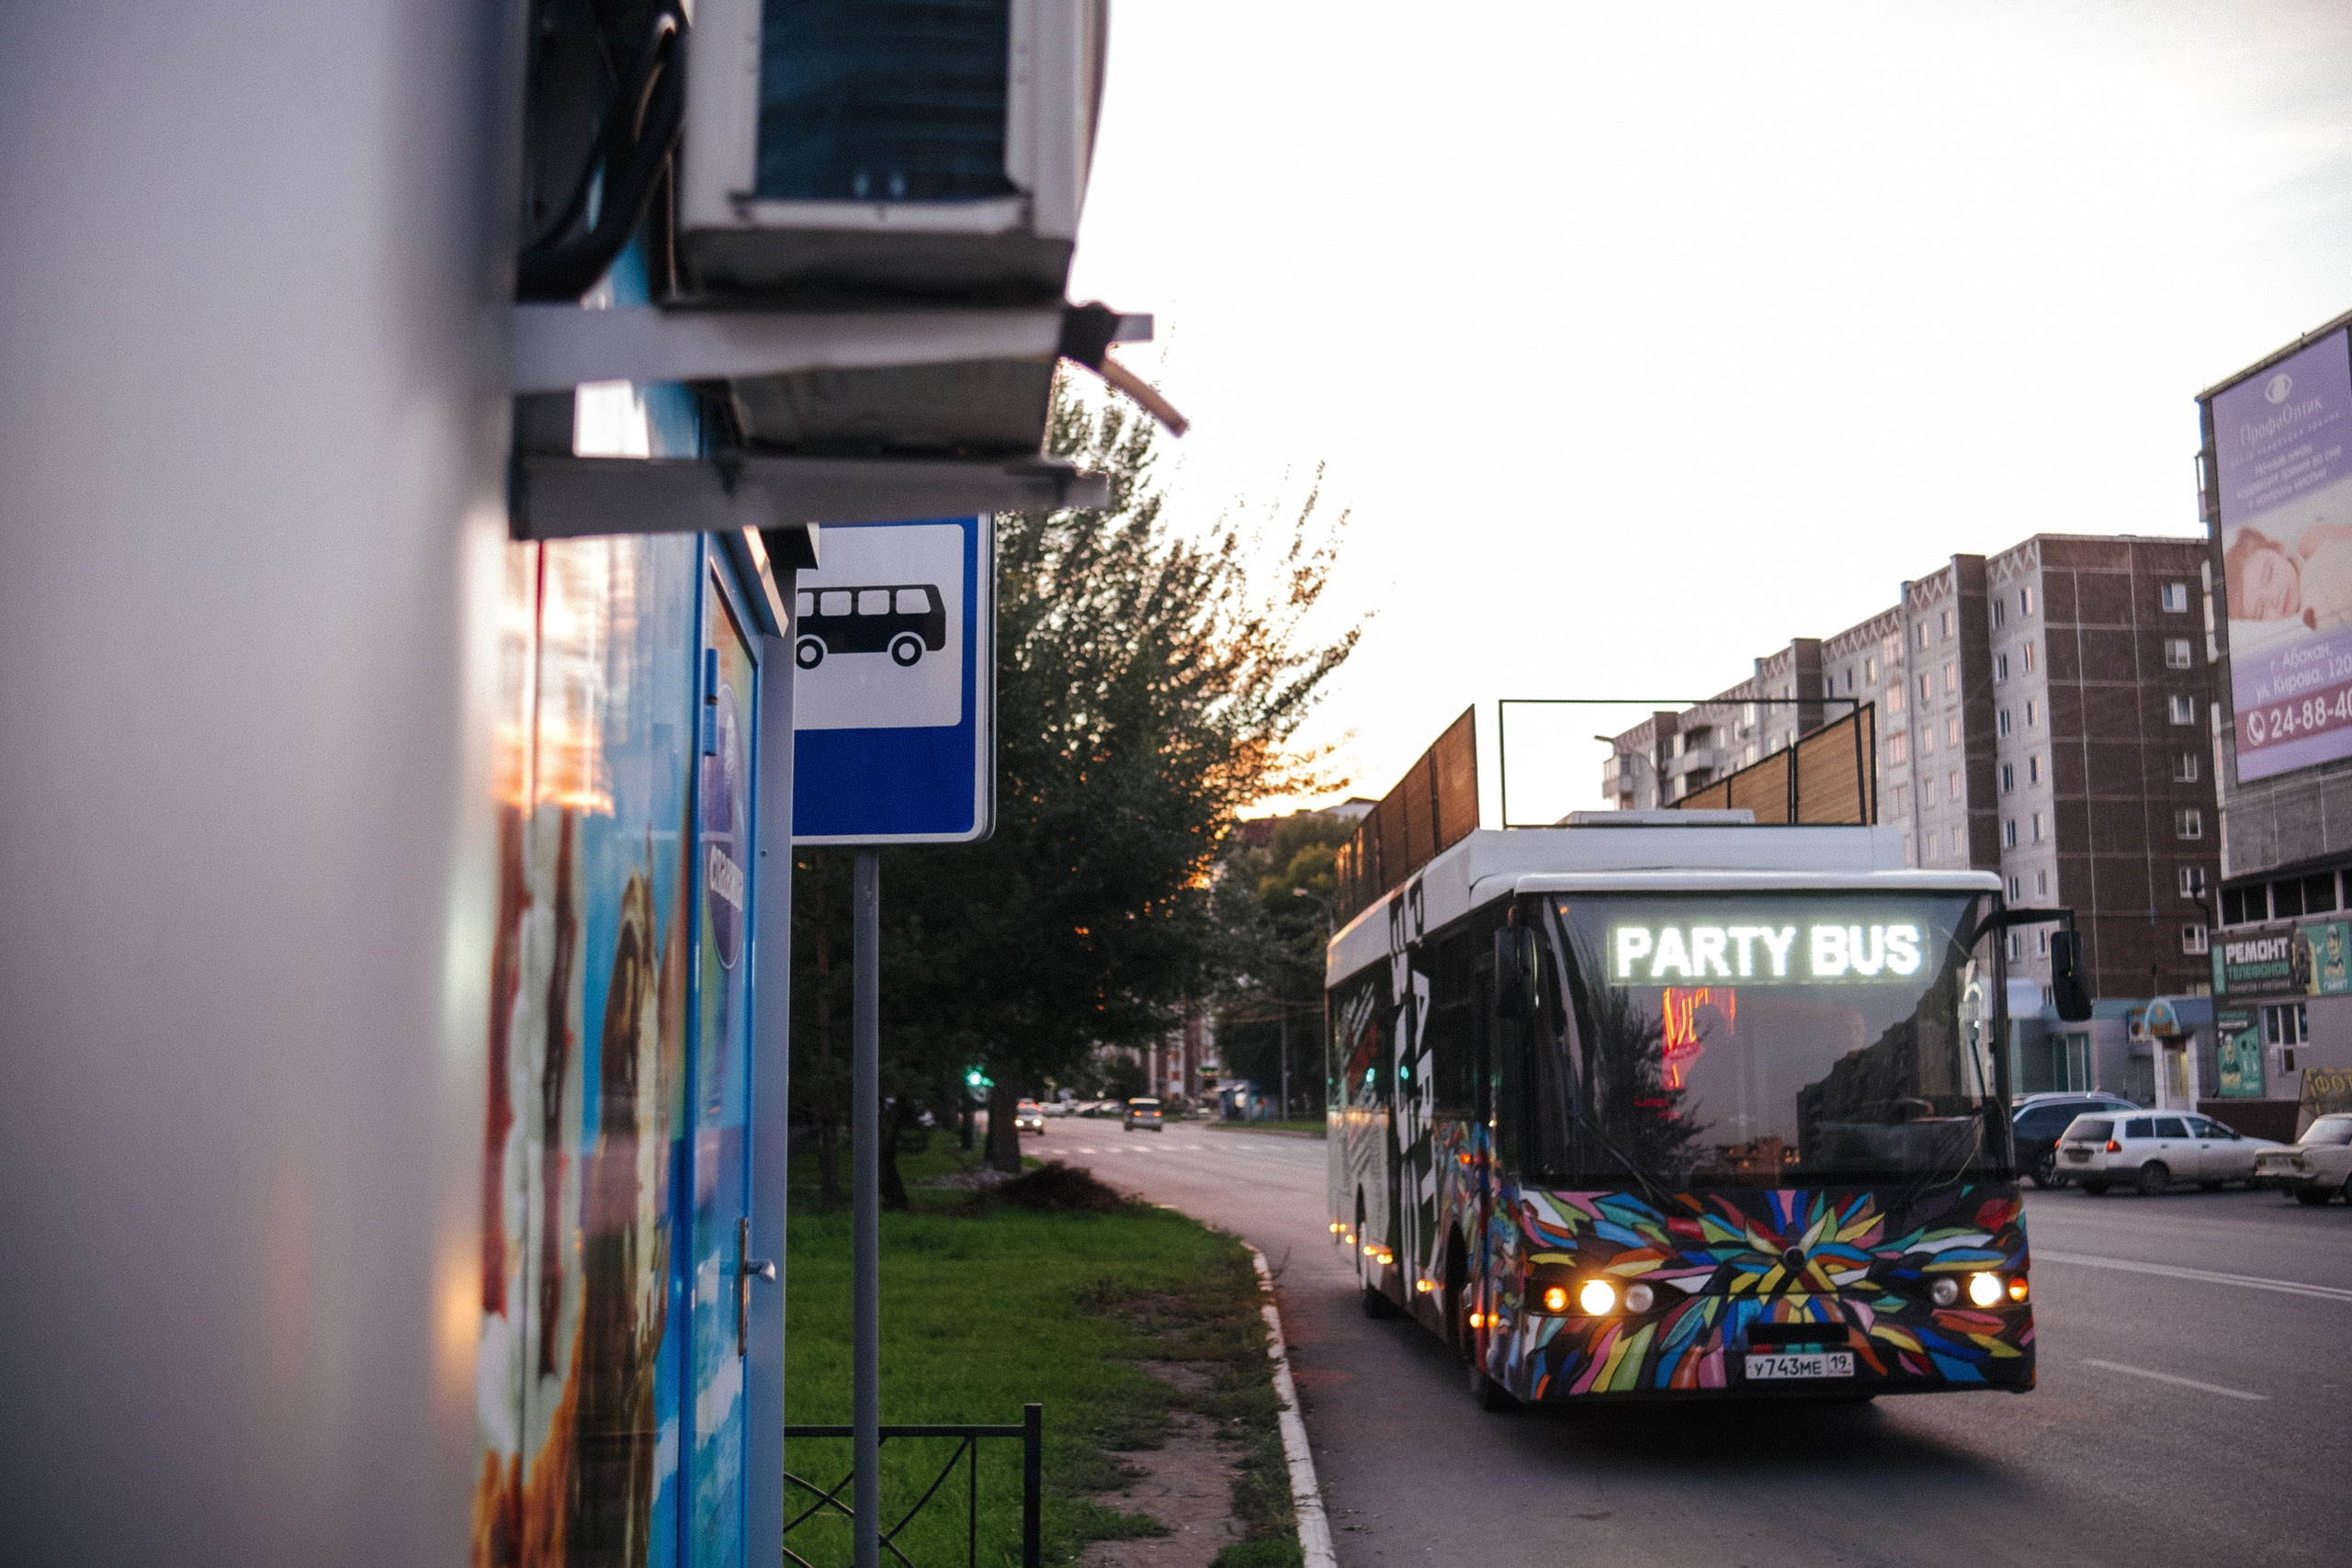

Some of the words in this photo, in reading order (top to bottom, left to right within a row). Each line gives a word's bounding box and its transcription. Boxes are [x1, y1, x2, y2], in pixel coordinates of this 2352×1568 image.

[2283, 643, 2333, 671] Абакан,
[2273, 668, 2324, 695] Кирова,
[2328, 652, 2352, 680] 120
[1617, 926, 1796, 976] PARTY
[1810, 924, 1923, 976] BUS
[2225, 937, 2288, 965] РЕМОНТ
[2226, 960, 2290, 981] ТЕЛЕФОНОВ
[1830, 1354, 1848, 1370] 19
